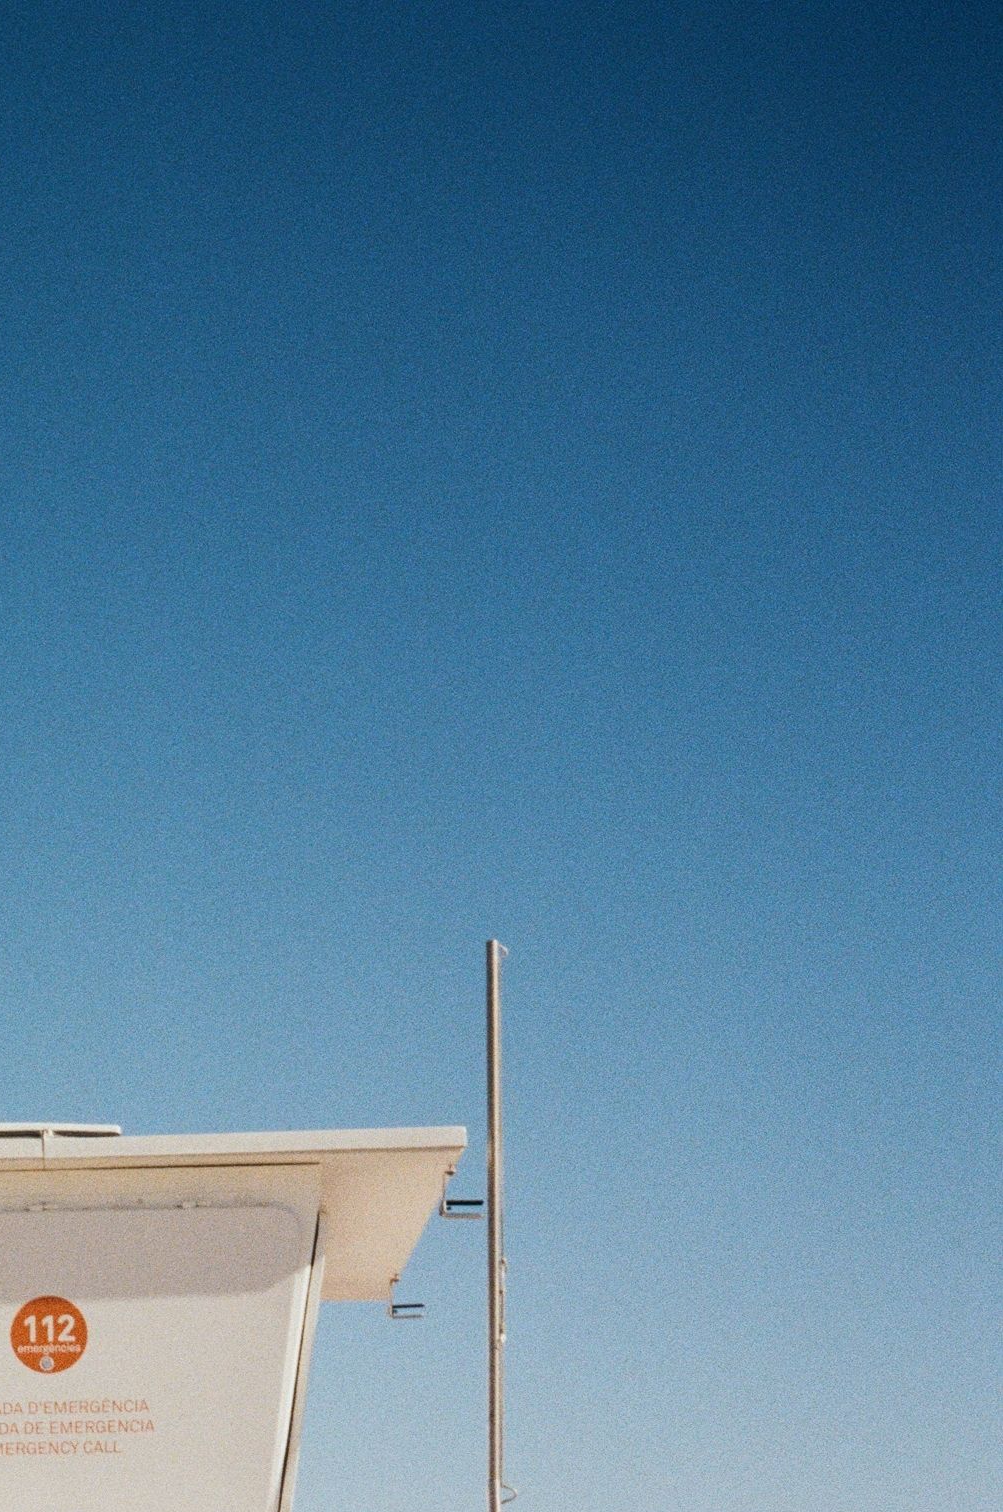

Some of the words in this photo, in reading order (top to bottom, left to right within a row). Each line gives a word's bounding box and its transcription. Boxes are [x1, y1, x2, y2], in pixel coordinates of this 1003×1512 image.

[23, 1313, 77, 1343] 112
[27, 1398, 150, 1415] D'EMERGÈNCIA
[24, 1420, 45, 1434] DE
[50, 1418, 156, 1434] EMERGENCIA
[83, 1439, 122, 1454] CALL
